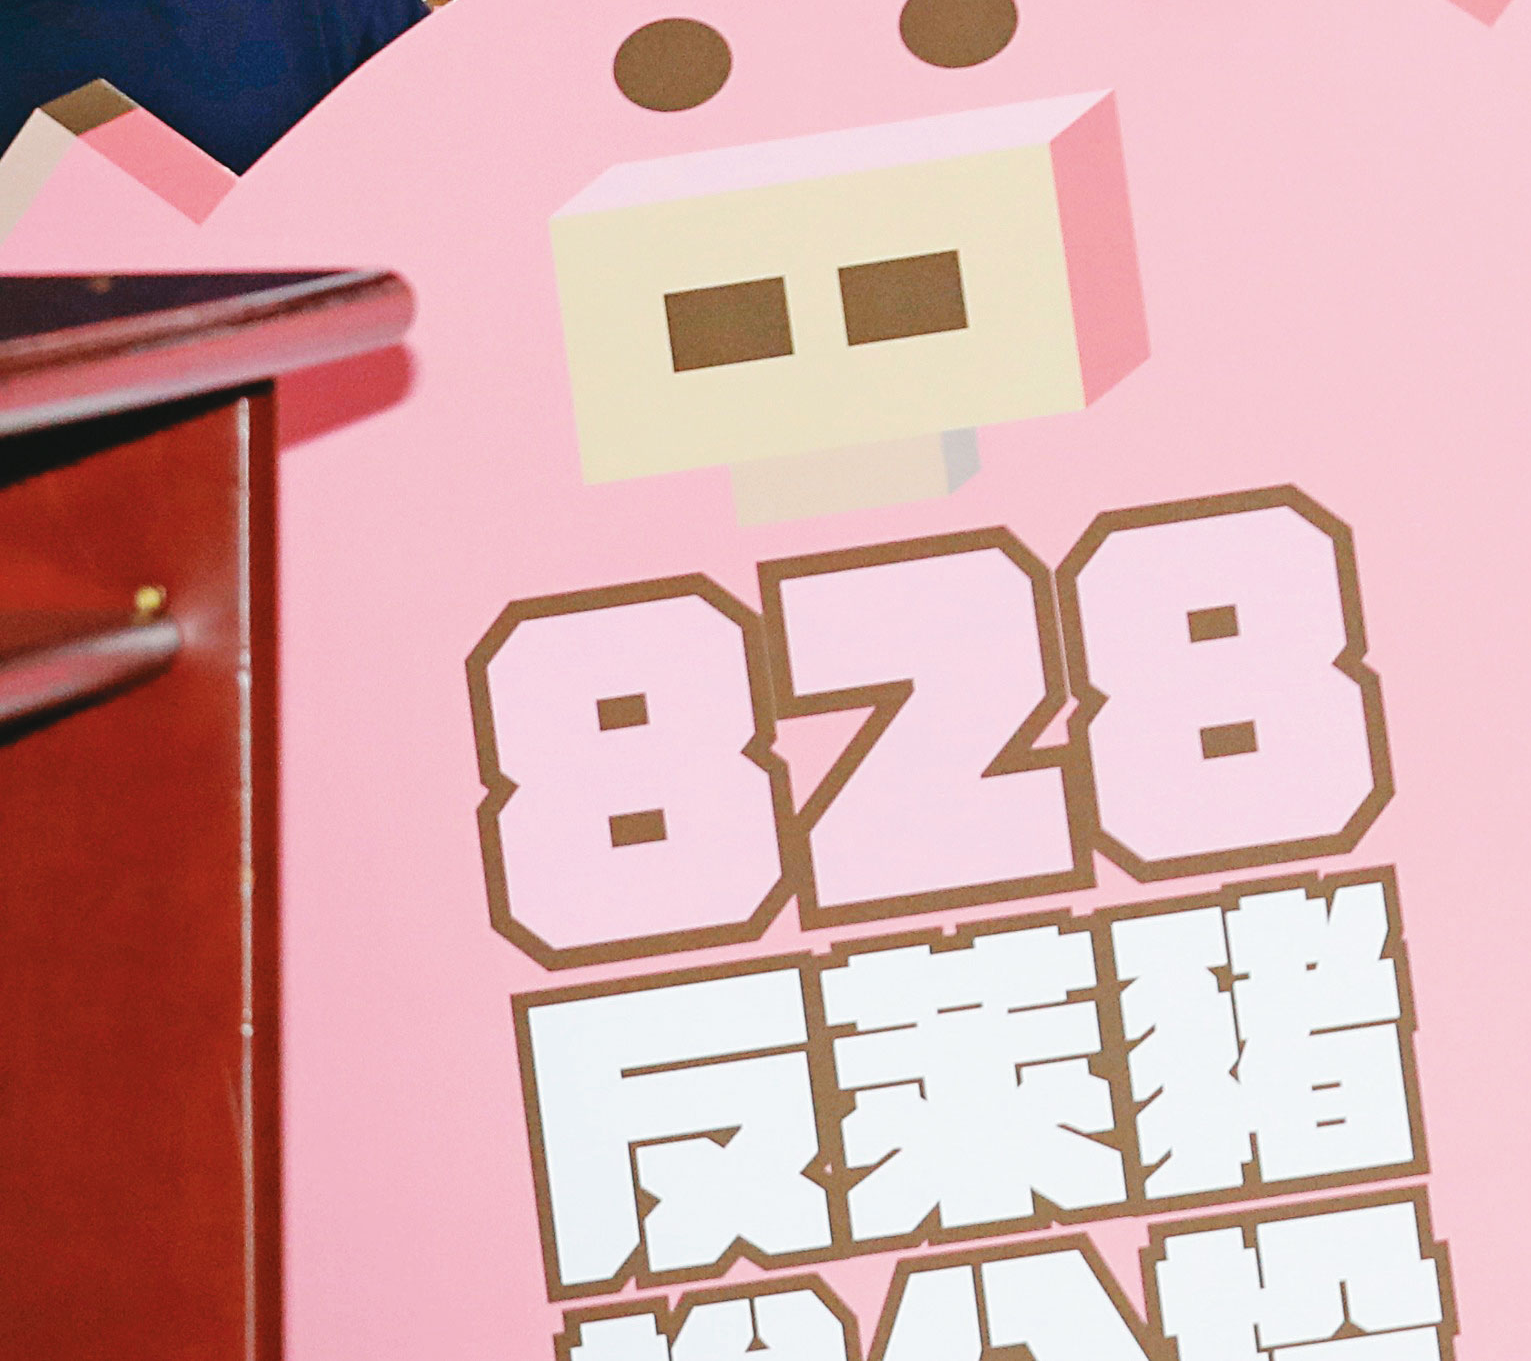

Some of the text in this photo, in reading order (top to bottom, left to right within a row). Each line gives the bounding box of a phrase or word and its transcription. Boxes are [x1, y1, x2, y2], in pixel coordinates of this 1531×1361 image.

[465, 484, 1395, 970] 828
[510, 864, 1431, 1303] 反萊豬
